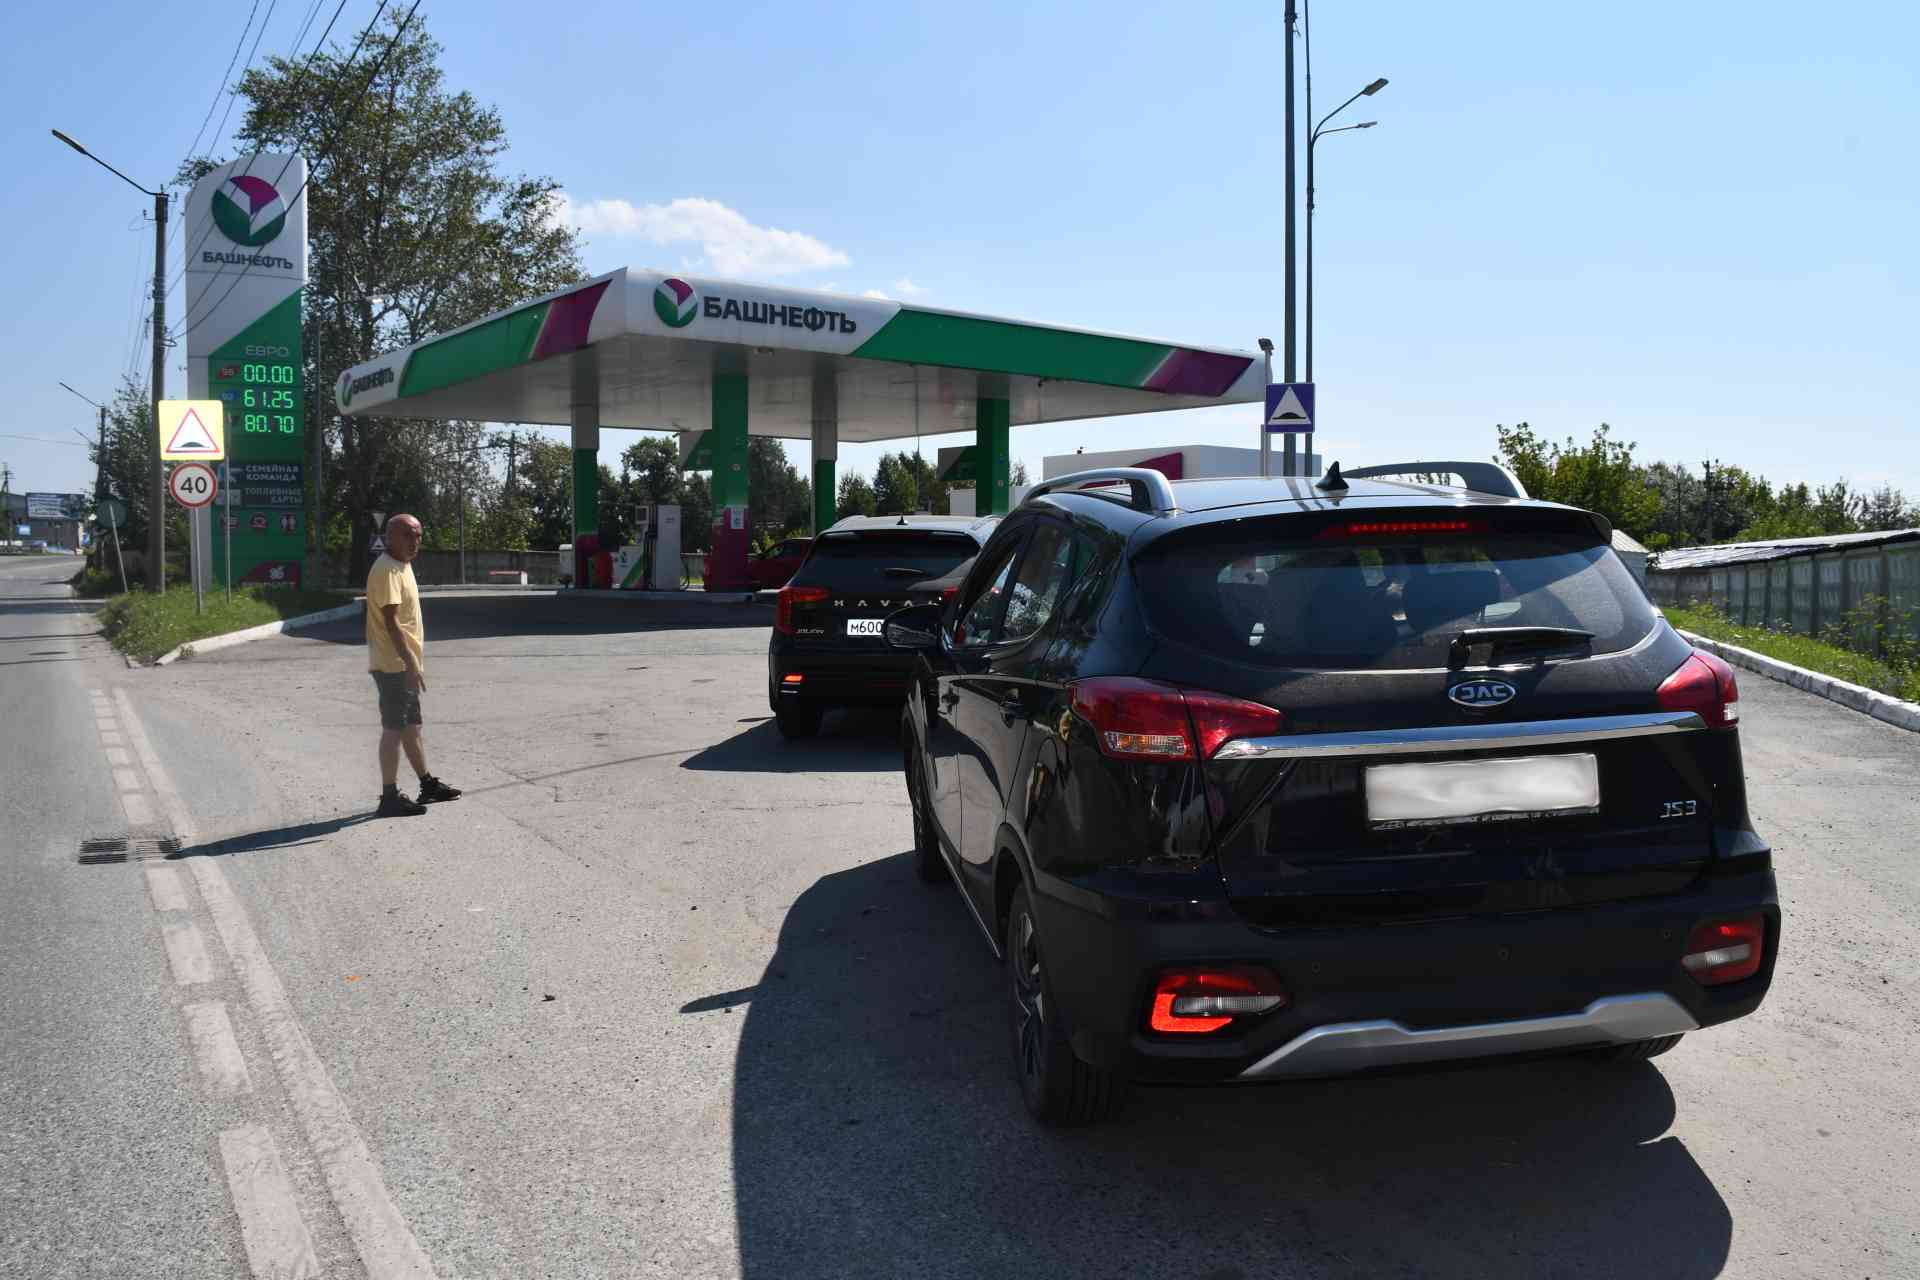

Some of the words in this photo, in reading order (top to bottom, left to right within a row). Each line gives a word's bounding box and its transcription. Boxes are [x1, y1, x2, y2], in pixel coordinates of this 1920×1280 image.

[203, 251, 293, 269] БАШНЕФТЬ
[703, 296, 857, 334] БАШНЕФТЬ
[246, 345, 289, 357] ЕВРО
[243, 364, 294, 384] 00.00
[244, 389, 294, 409] 61.25
[244, 414, 295, 433] 80.70
[245, 464, 299, 473] СЕМЕЙНАЯ
[246, 473, 297, 481] КОМАНДА
[180, 476, 207, 494] 40
[1461, 685, 1507, 699] JAC
[1659, 800, 1697, 818] JS3
